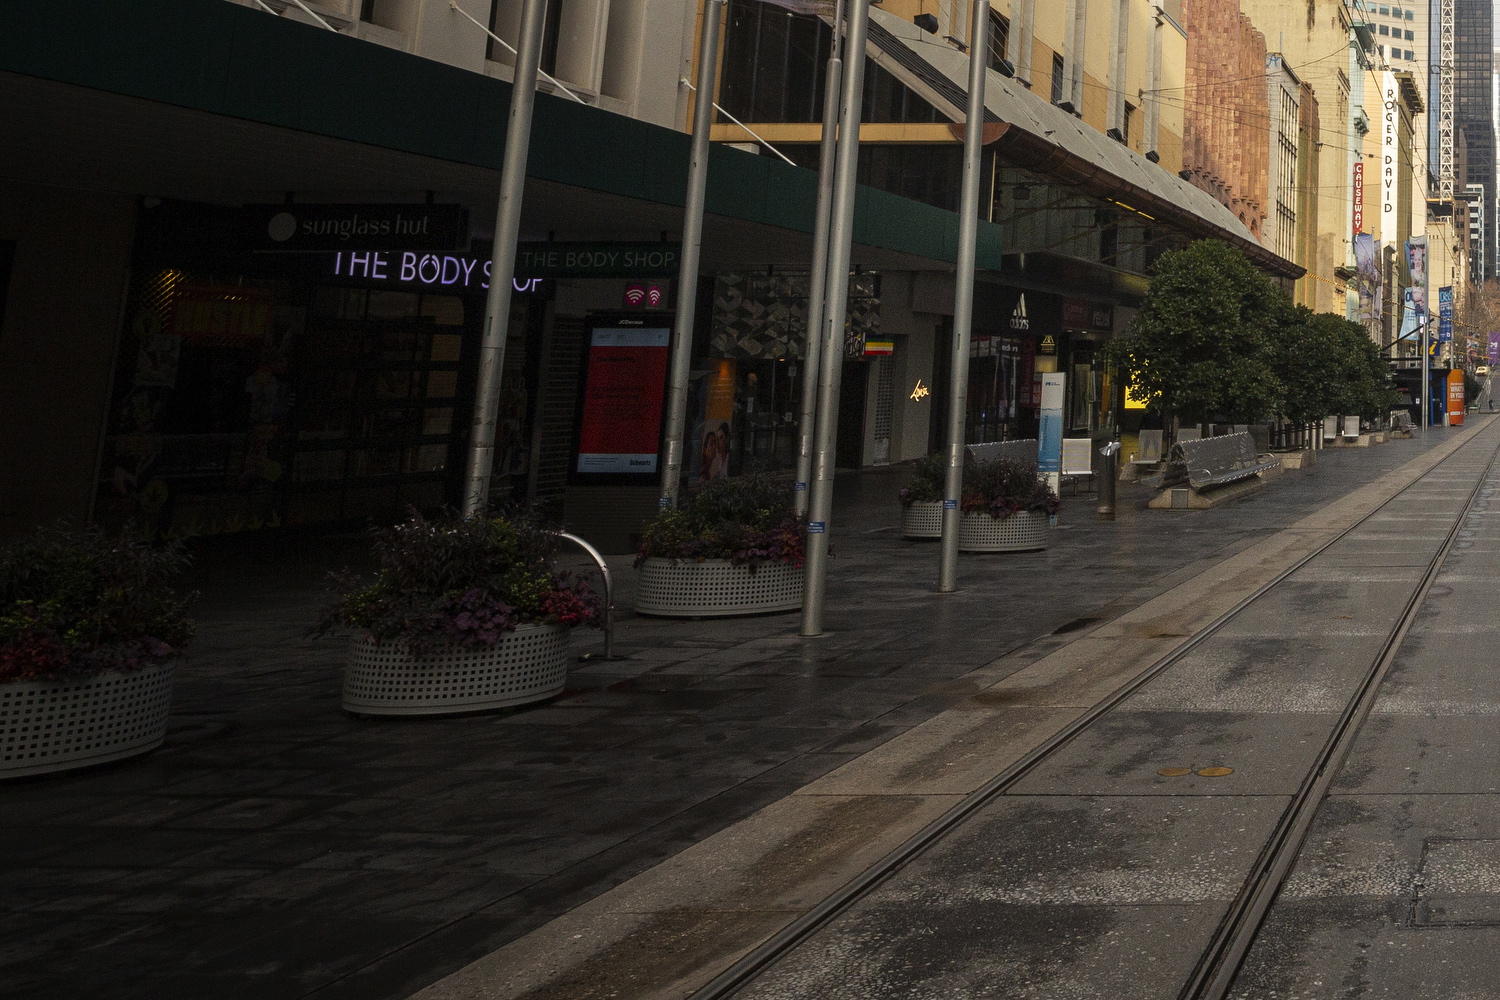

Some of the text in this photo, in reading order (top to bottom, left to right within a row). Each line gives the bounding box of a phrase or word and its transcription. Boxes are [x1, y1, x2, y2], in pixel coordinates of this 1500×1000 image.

[1384, 89, 1394, 213] ROGER DAVID
[1354, 164, 1363, 229] CAUSEWAY
[302, 213, 429, 240] sunglass hut
[335, 252, 387, 280] THE
[400, 252, 477, 287] BODY
[523, 251, 676, 268] THE BODY SHOP
